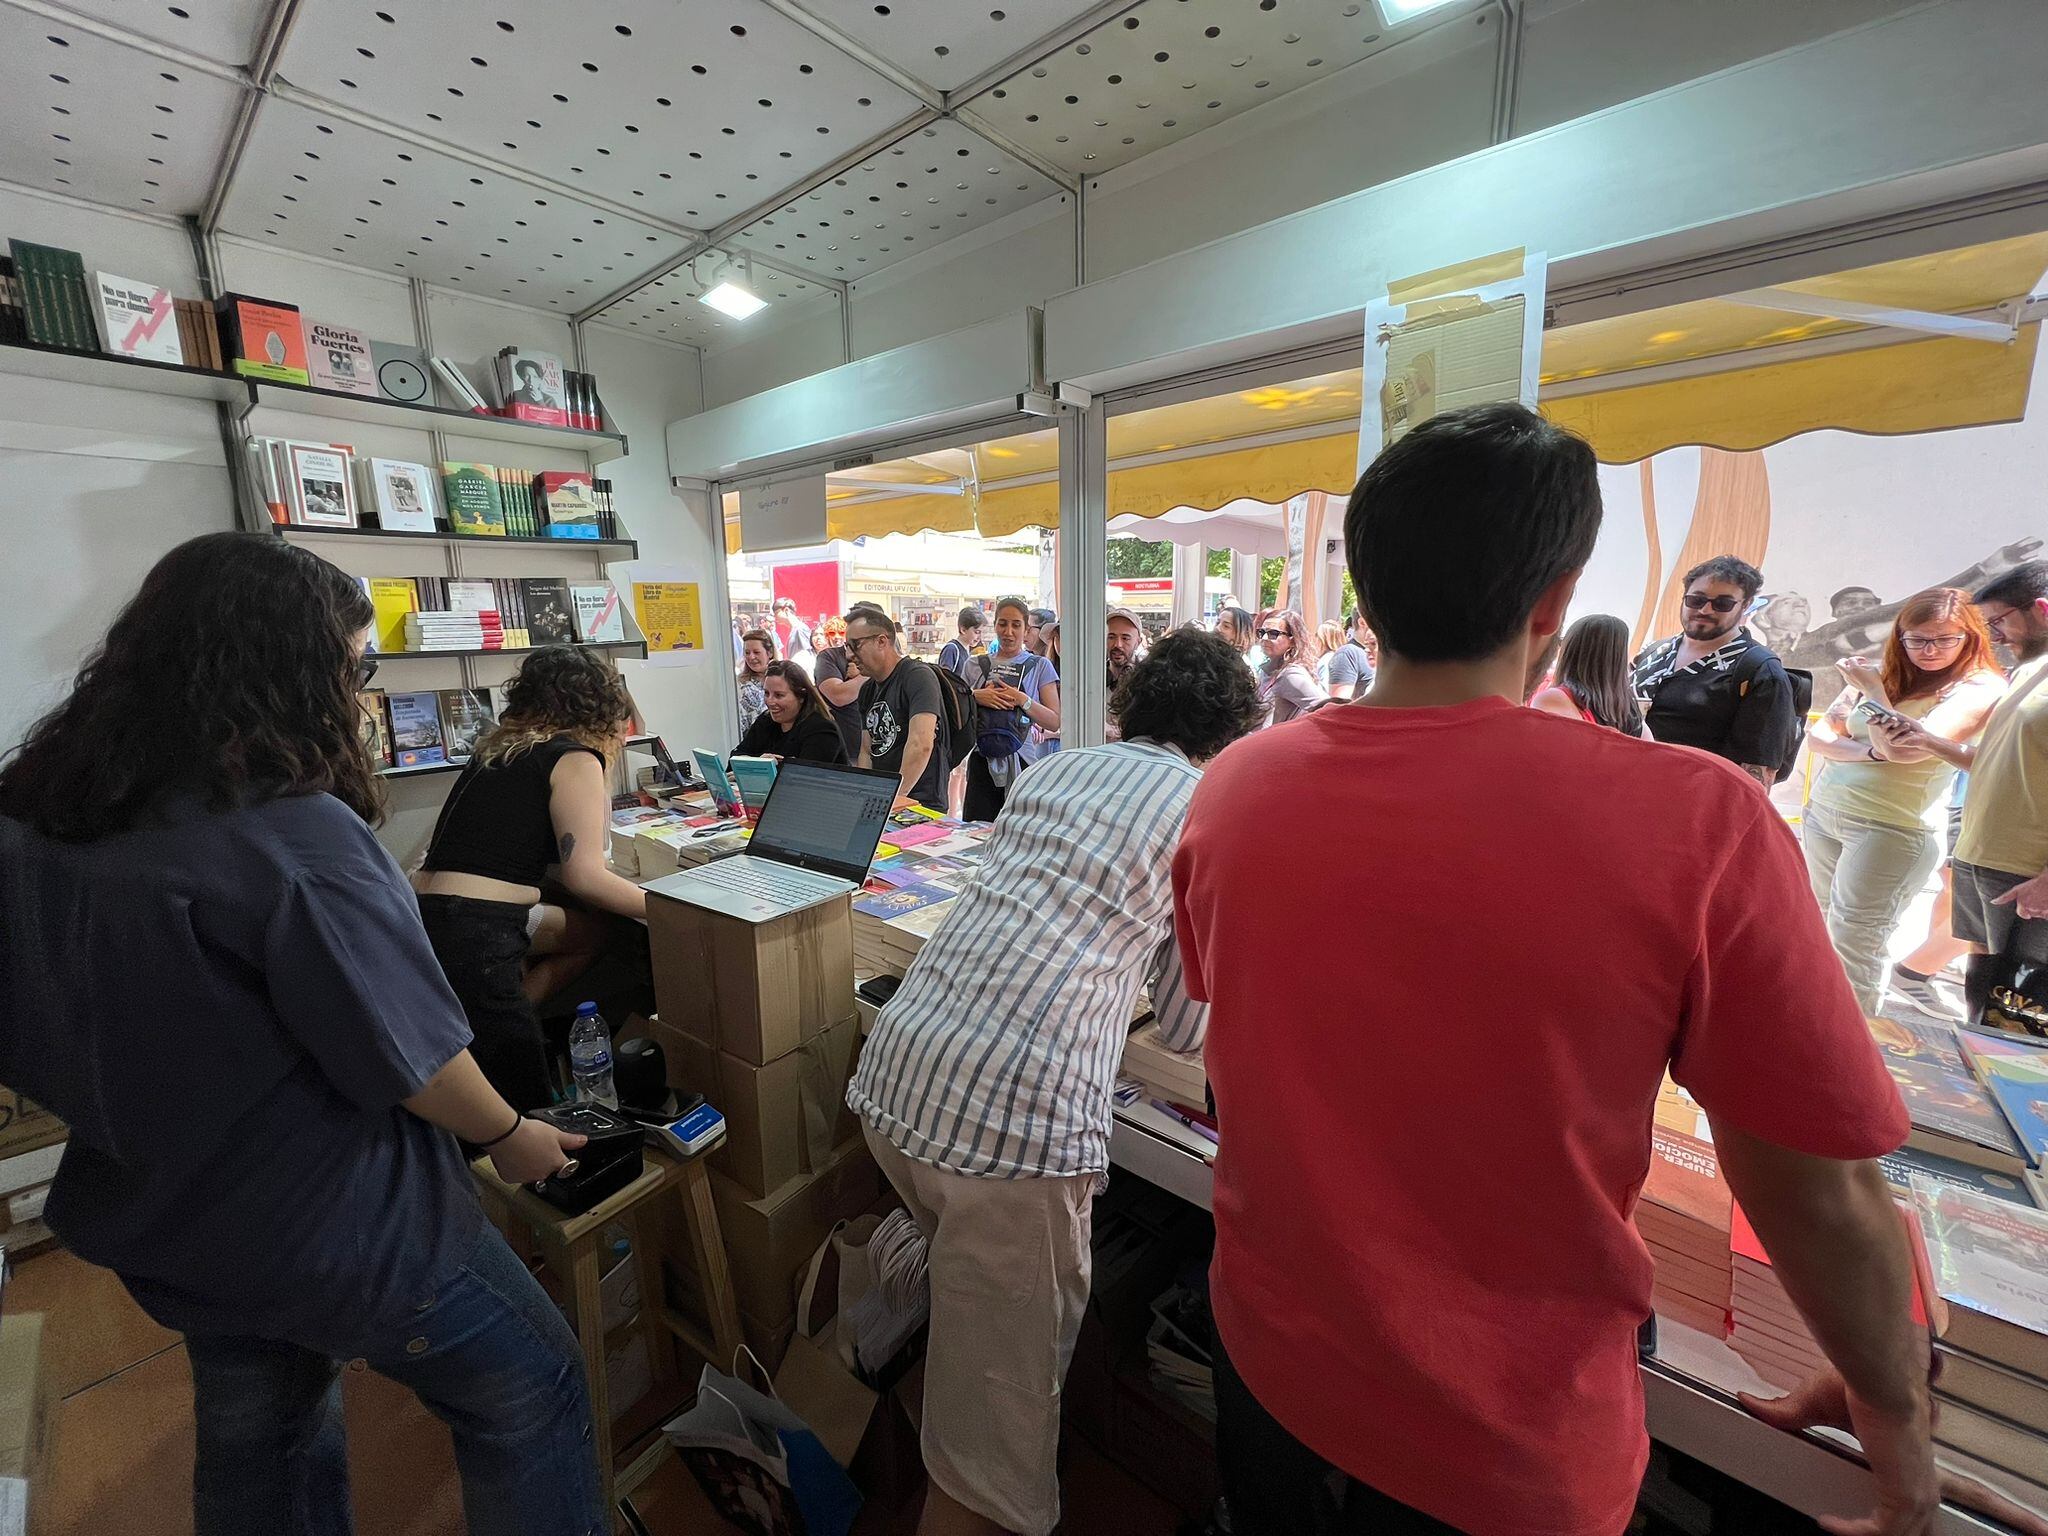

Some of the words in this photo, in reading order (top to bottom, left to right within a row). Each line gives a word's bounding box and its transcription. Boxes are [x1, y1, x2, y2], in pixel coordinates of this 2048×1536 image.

[311, 334, 365, 354] Fuertes
[314, 325, 359, 343] Gloria
[864, 583, 893, 592] EDITORIAL
[1652, 1141, 1716, 1170] EMOCIO
[1658, 1153, 1716, 1179] SUPER-
